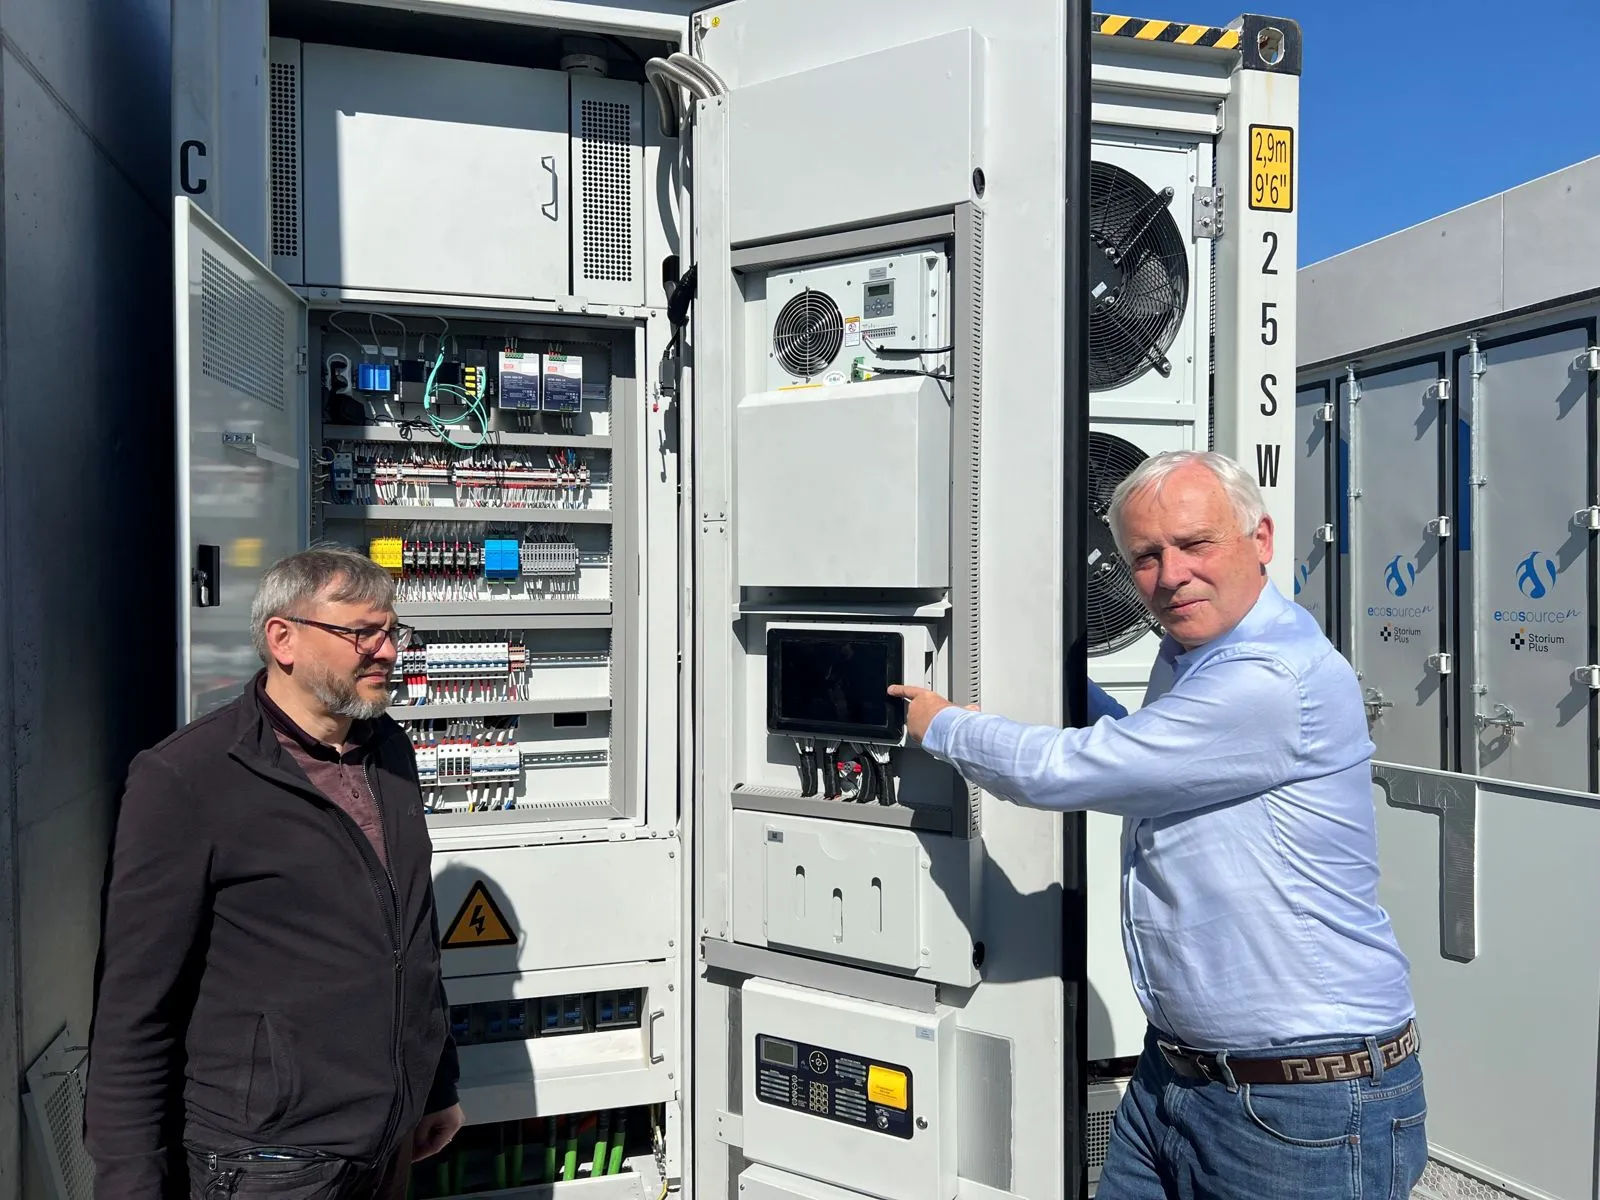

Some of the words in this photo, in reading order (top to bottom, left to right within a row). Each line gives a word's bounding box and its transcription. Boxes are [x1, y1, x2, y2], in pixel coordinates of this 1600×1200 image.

[1255, 131, 1287, 168] 2,9m
[180, 140, 207, 194] C
[1255, 173, 1287, 204] 9'6"
[1393, 626, 1421, 636] Storium
[1393, 634, 1409, 643] Plus
[1528, 633, 1565, 644] Storium
[1528, 643, 1549, 653] Plus
